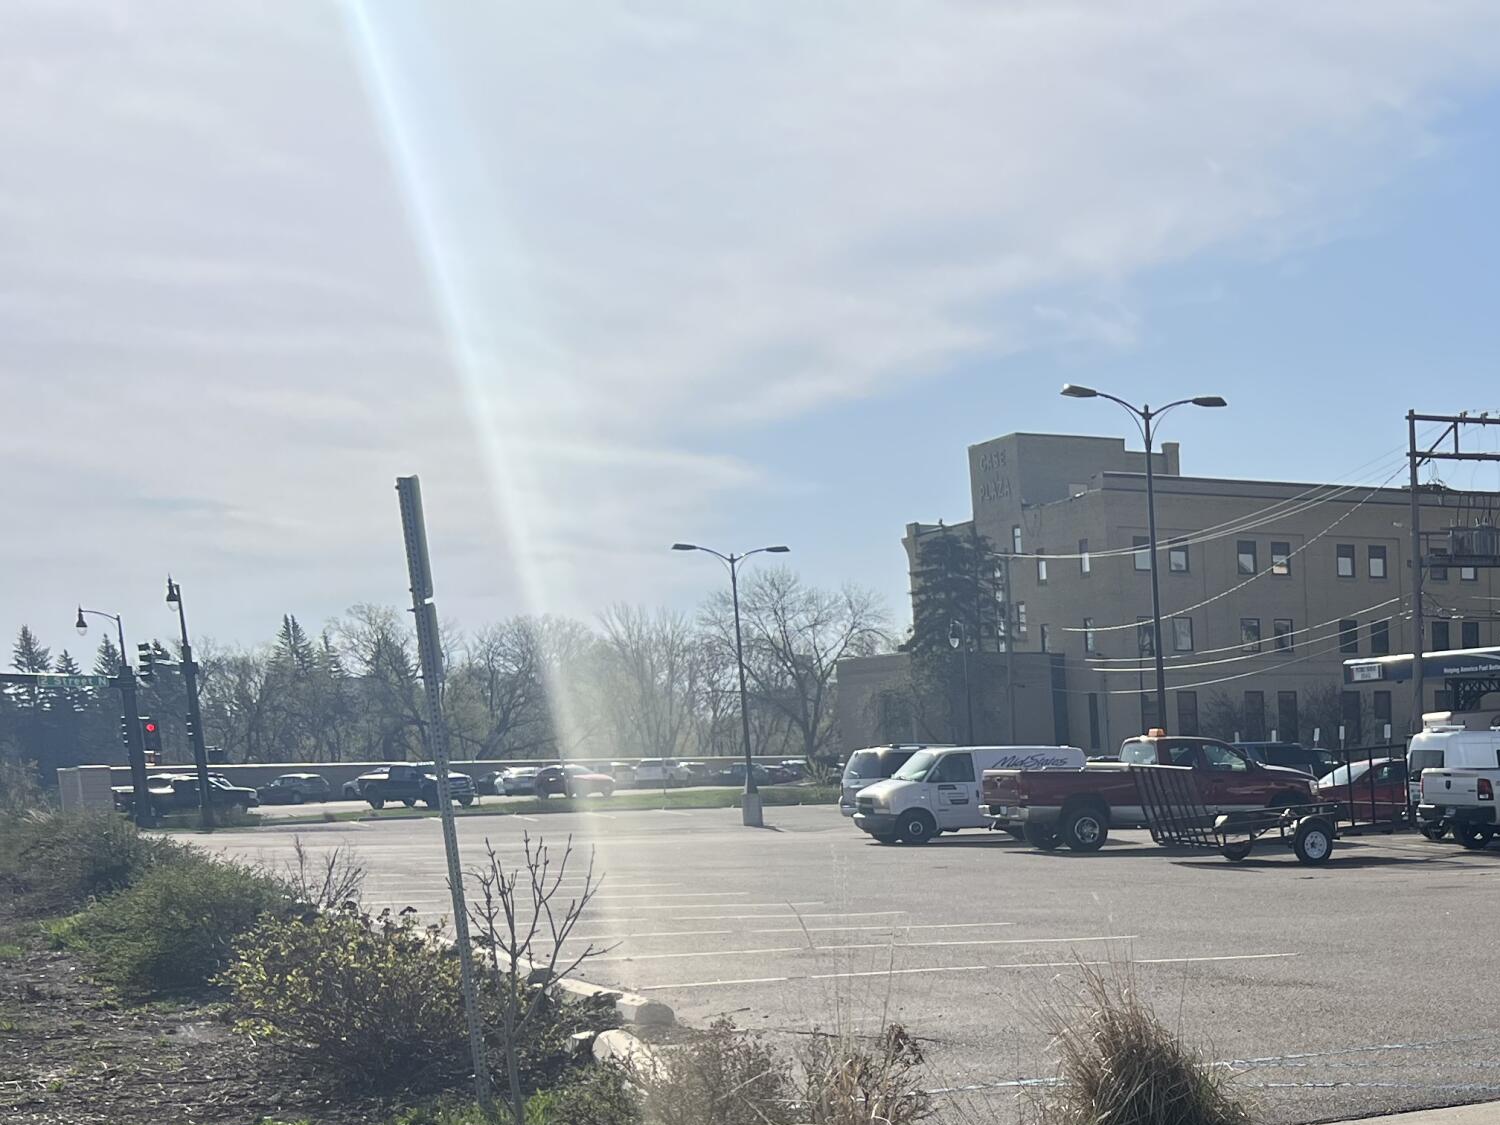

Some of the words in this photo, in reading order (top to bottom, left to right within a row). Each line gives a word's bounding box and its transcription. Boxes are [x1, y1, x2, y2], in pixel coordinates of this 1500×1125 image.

[979, 478, 1013, 504] PLAZA
[54, 676, 94, 686] Street
[98, 676, 107, 686] N
[992, 753, 1068, 768] MidStates
